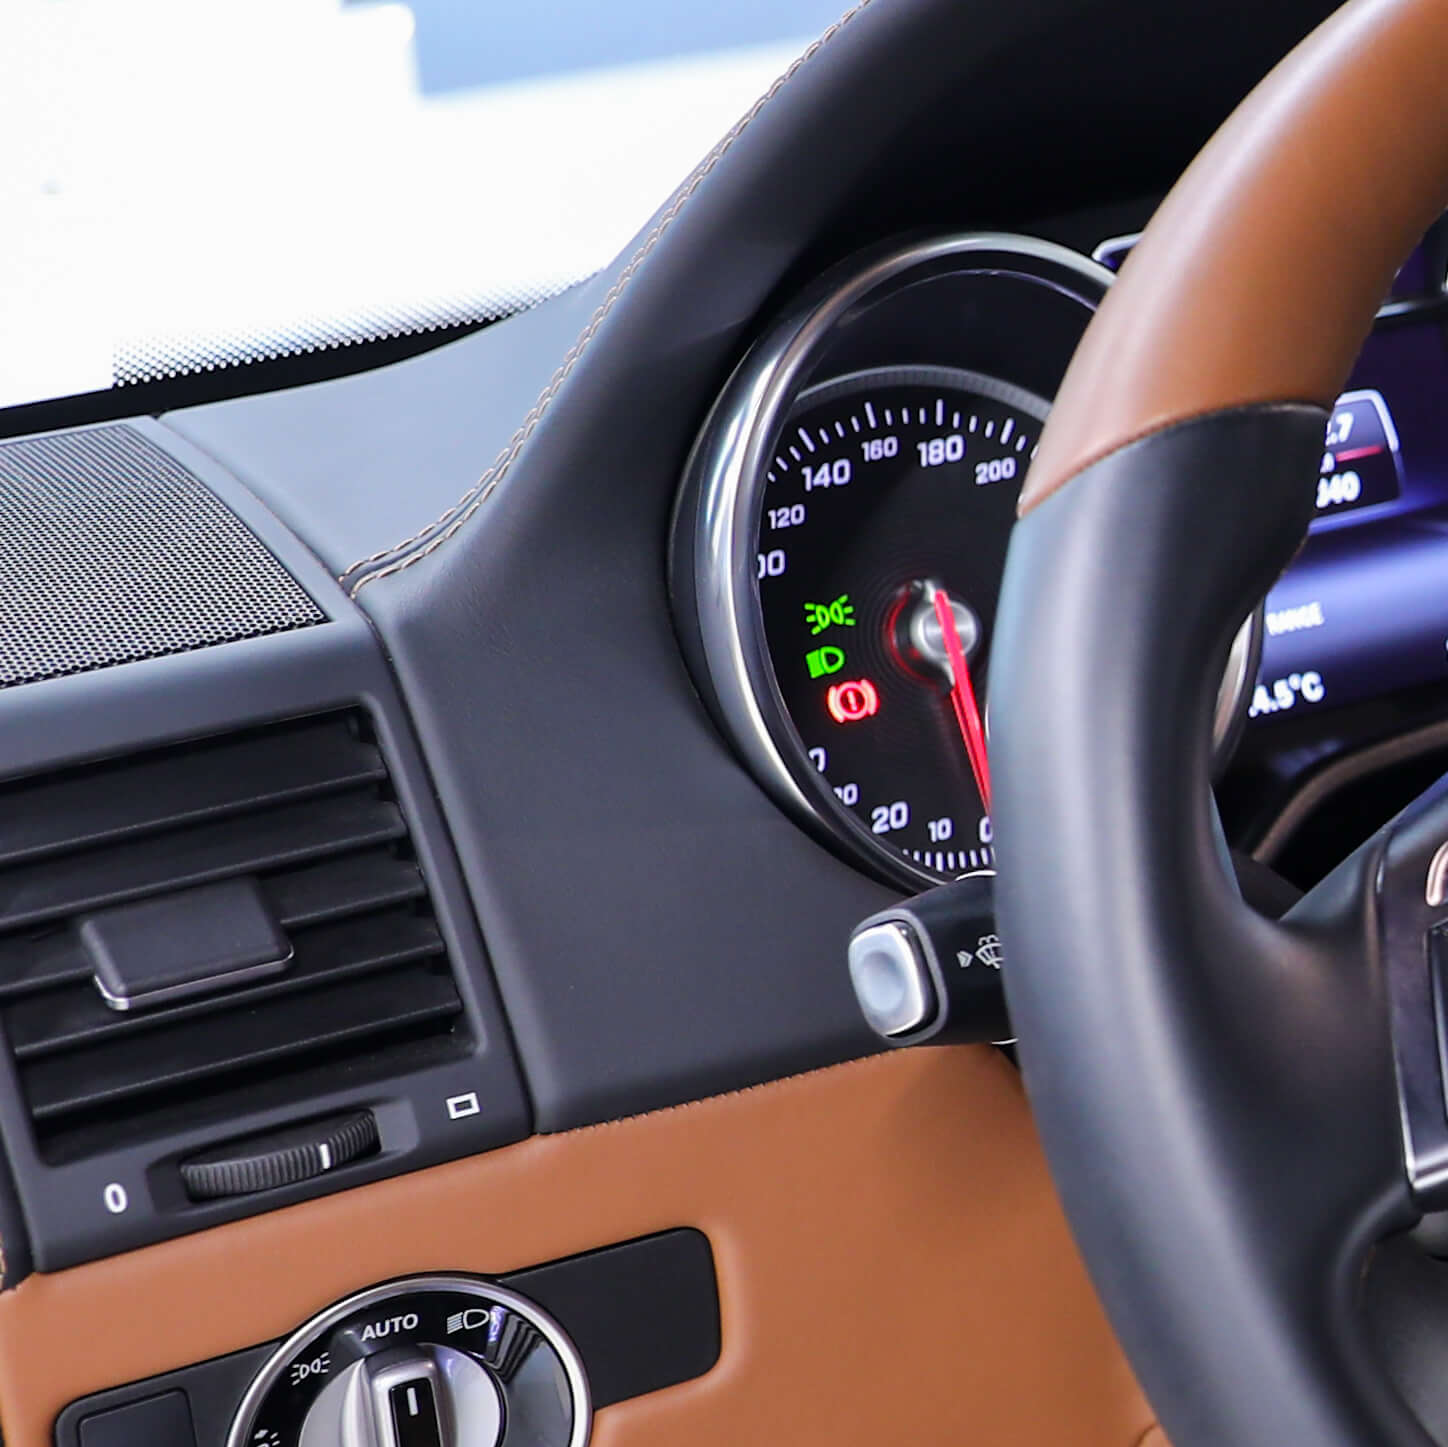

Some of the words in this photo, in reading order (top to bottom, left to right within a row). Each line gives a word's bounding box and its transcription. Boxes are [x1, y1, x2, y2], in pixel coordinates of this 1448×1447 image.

[861, 436, 899, 463] 160
[917, 434, 964, 468] 180
[801, 458, 851, 492] 140
[975, 457, 1017, 486] 200
[768, 504, 806, 530] 120
[871, 801, 910, 835] 20
[927, 817, 954, 843] 10
[104, 1182, 128, 1214] 0
[361, 1312, 420, 1342] AUTO
